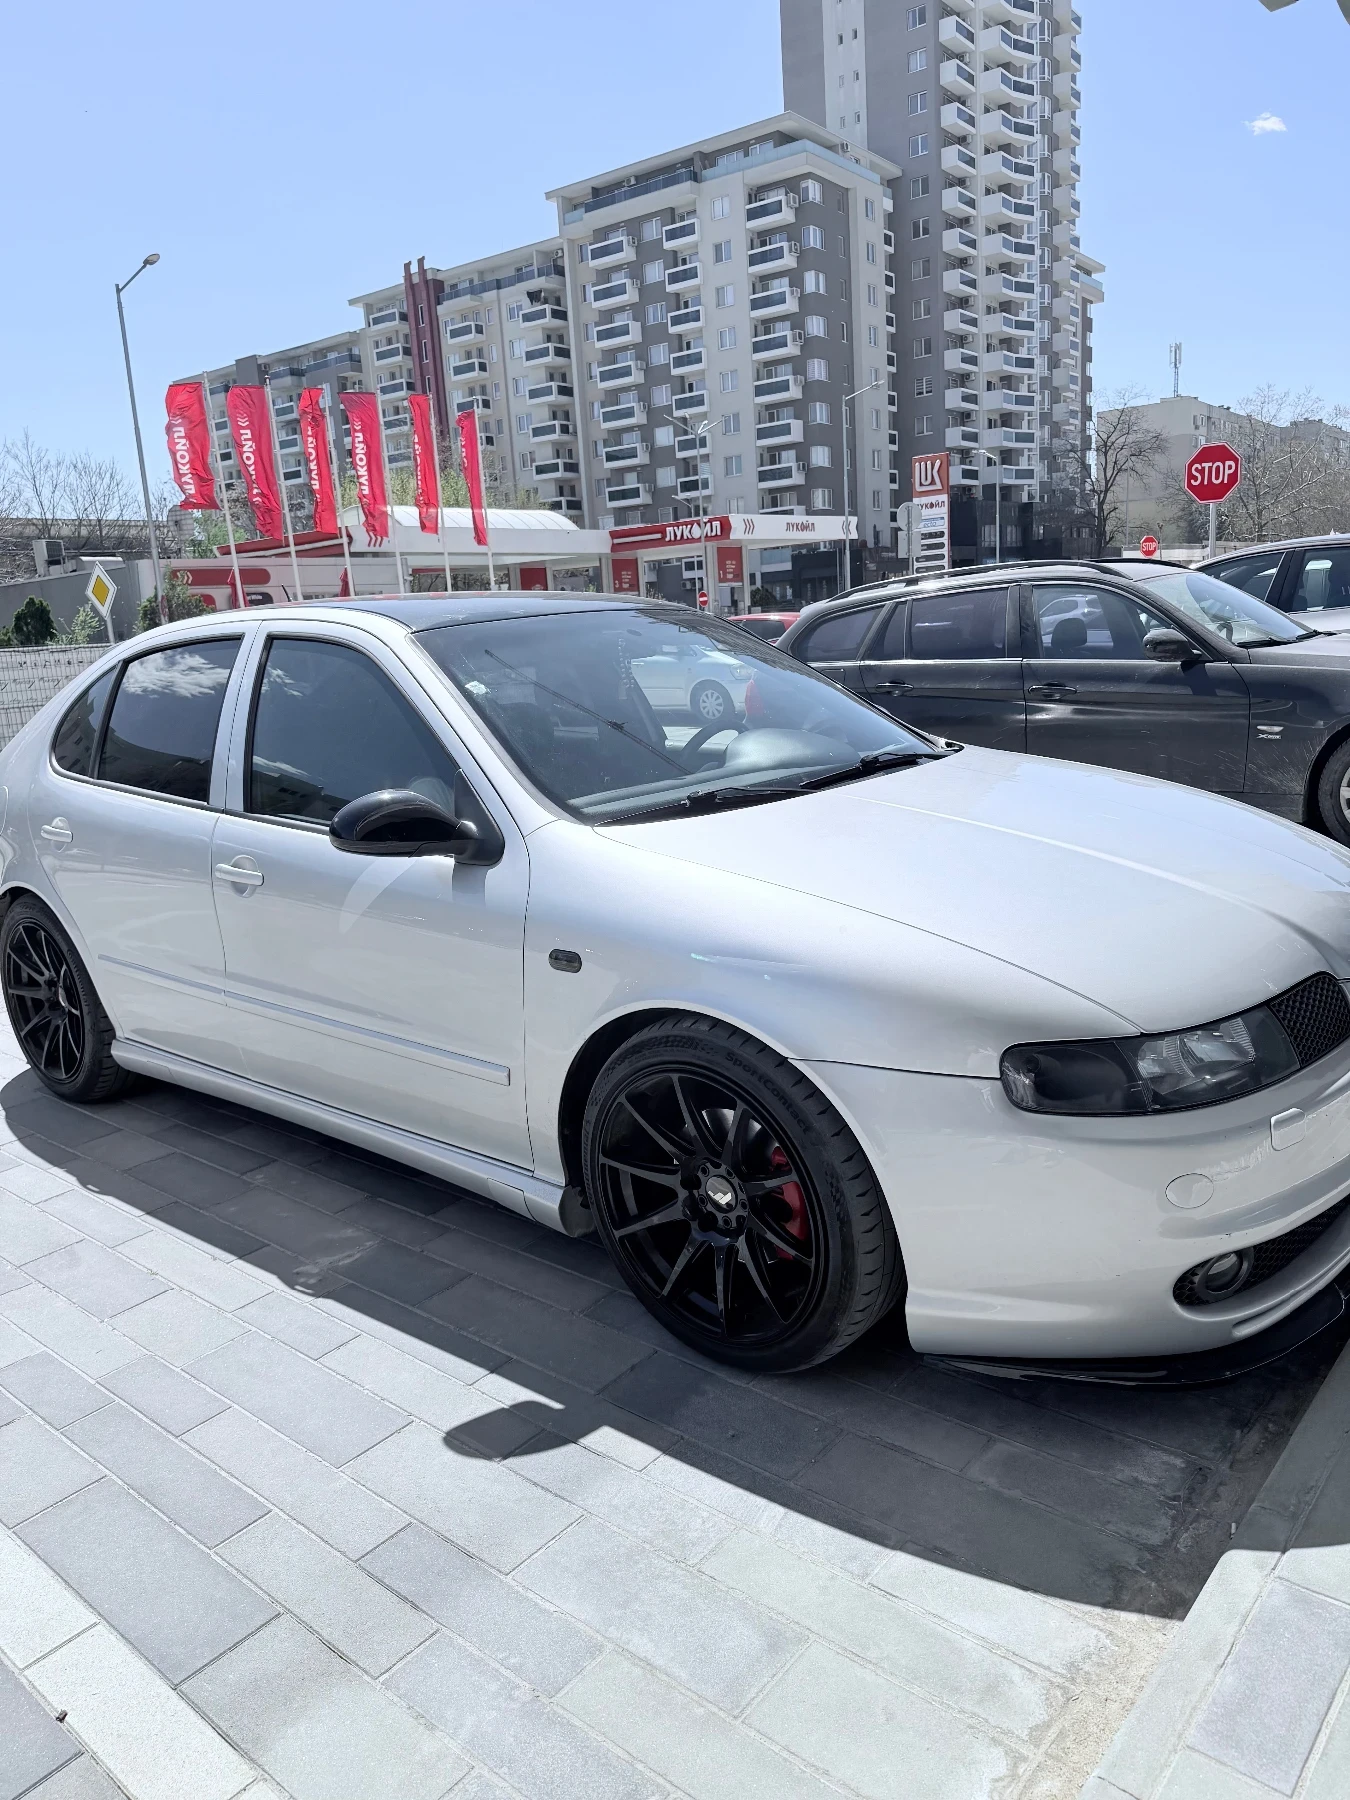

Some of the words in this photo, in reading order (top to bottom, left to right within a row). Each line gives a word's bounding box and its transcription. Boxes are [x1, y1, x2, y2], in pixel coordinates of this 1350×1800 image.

[1190, 460, 1236, 485] STOP
[917, 500, 945, 511] УКОЙЛ
[665, 518, 721, 542] ЛУКОЙЛ
[785, 521, 815, 532] ЛУКОЙЛ
[1142, 542, 1157, 551] STOP
[724, 1051, 810, 1135] SportContact
